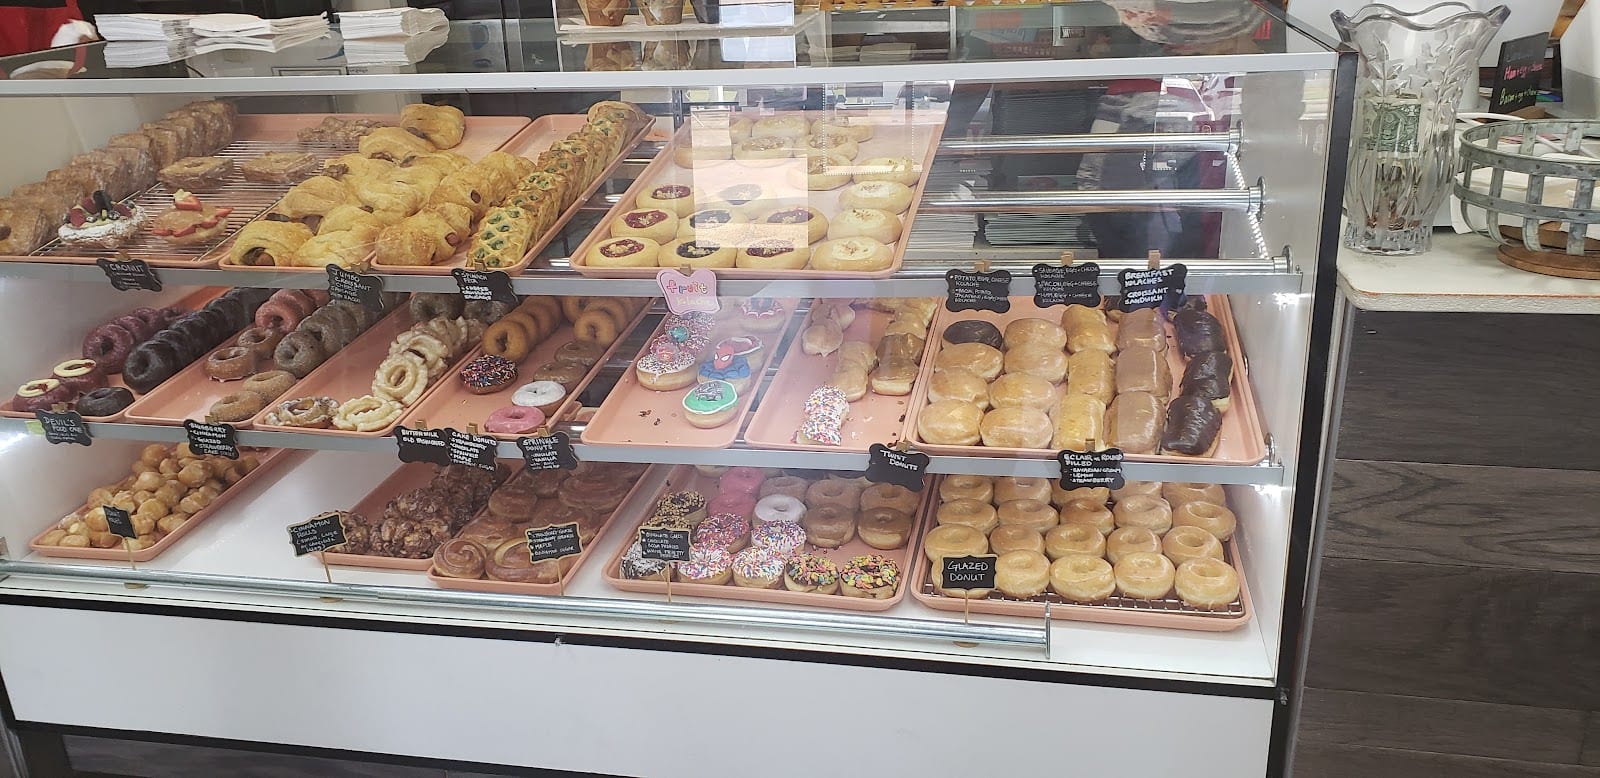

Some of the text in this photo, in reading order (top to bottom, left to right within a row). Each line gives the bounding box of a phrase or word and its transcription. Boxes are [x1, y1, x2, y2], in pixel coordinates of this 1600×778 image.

[109, 263, 145, 273] CRONUT
[331, 267, 360, 283] JUMBO
[461, 271, 488, 281] SPINACH
[1124, 268, 1175, 281] BREAKFAST
[335, 276, 372, 291] CROISSANT
[667, 279, 708, 294] fruit
[1124, 276, 1163, 288] KOLACHES
[1127, 287, 1169, 299] CROISSANT
[1124, 294, 1163, 305] SANDWICH
[42, 416, 76, 426] DEVIL'S
[52, 425, 67, 433] FOOD
[190, 422, 226, 433] BLUEBERRY
[192, 430, 226, 438] CINNAMON
[451, 431, 497, 446] CAKE DONUTS
[402, 436, 415, 444] OLD
[522, 436, 559, 446] SPRINKLE
[199, 443, 234, 452] STRAWBERRY
[880, 449, 908, 462] TWIST
[889, 458, 919, 471] DONUTS
[292, 519, 331, 533] CINNAMON
[296, 529, 318, 538] ROLLS
[947, 560, 989, 571] GLAZED
[949, 572, 986, 582] DONUT
